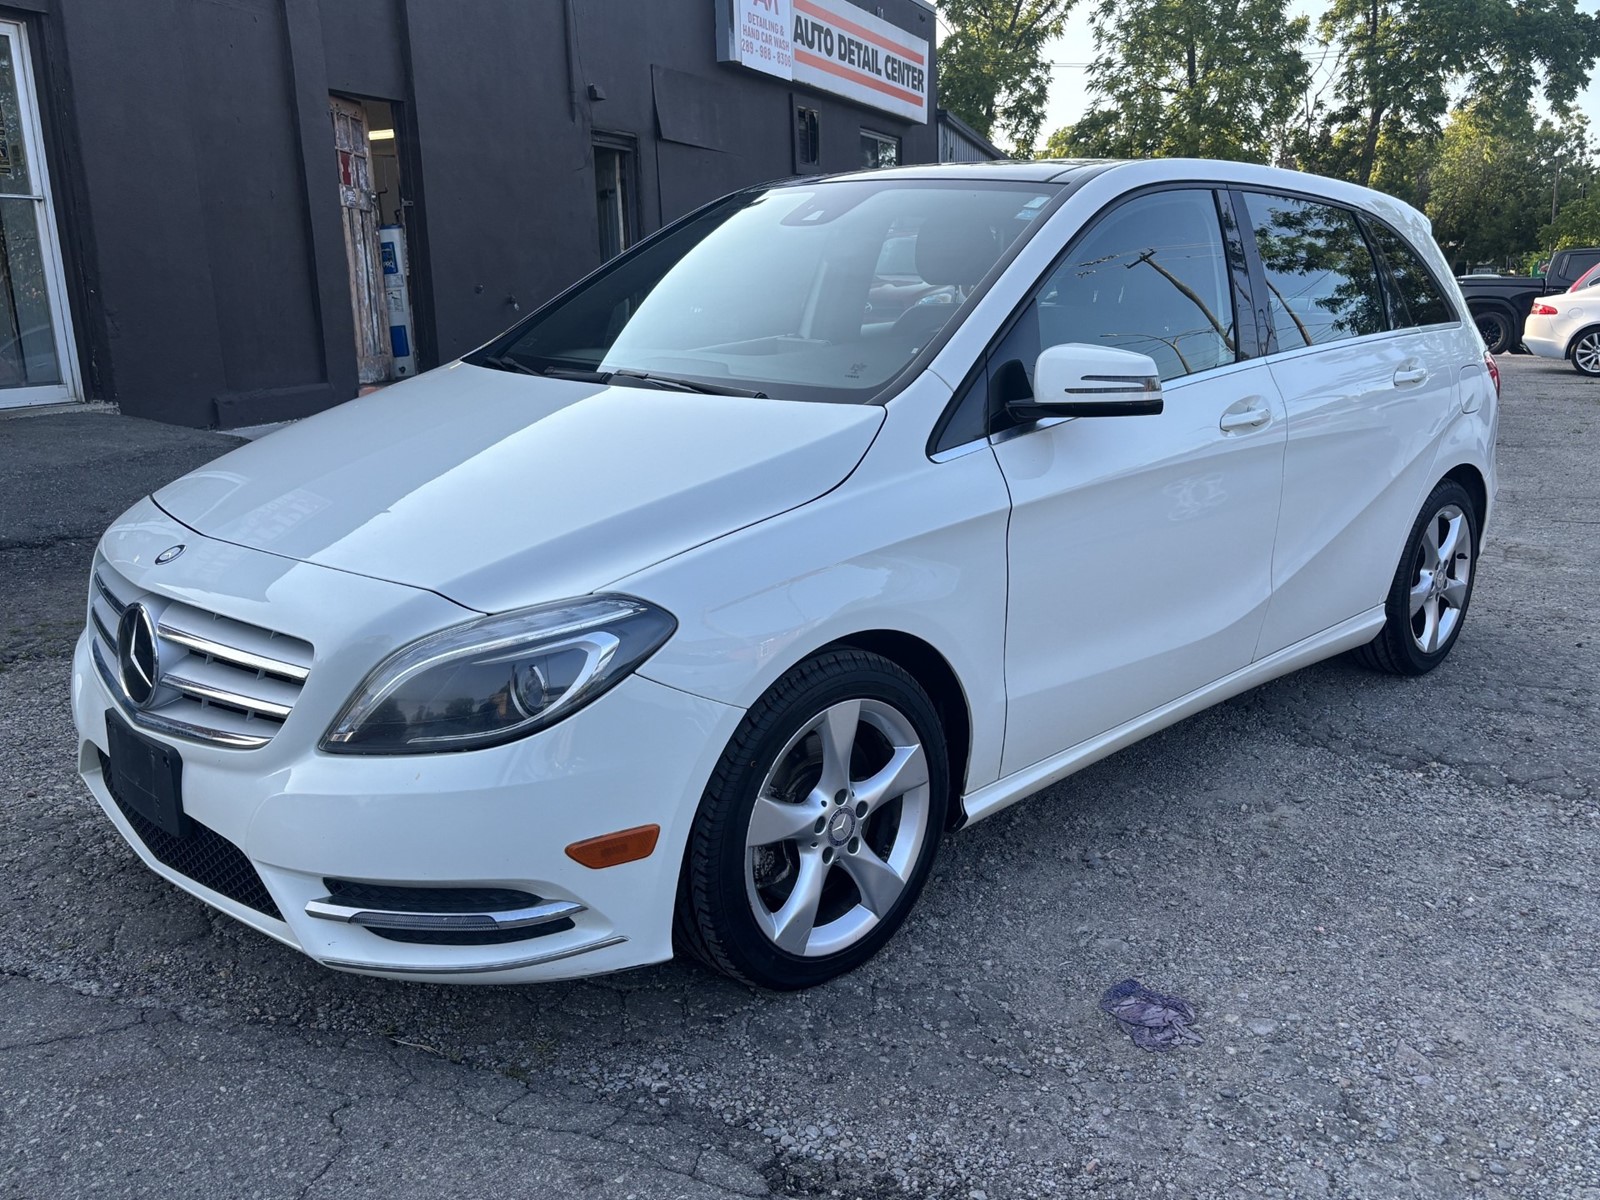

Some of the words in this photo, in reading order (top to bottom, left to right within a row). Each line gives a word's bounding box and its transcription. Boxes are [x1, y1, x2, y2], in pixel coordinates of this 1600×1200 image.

[747, 12, 779, 34] DETAILING
[780, 25, 785, 37] &
[741, 39, 754, 54] 289
[742, 24, 760, 41] HAND
[761, 31, 773, 46] CAR
[773, 36, 790, 52] WASH
[793, 15, 834, 57] AUTO
[838, 33, 882, 76] DETAIL
[885, 55, 924, 93] CENTER
